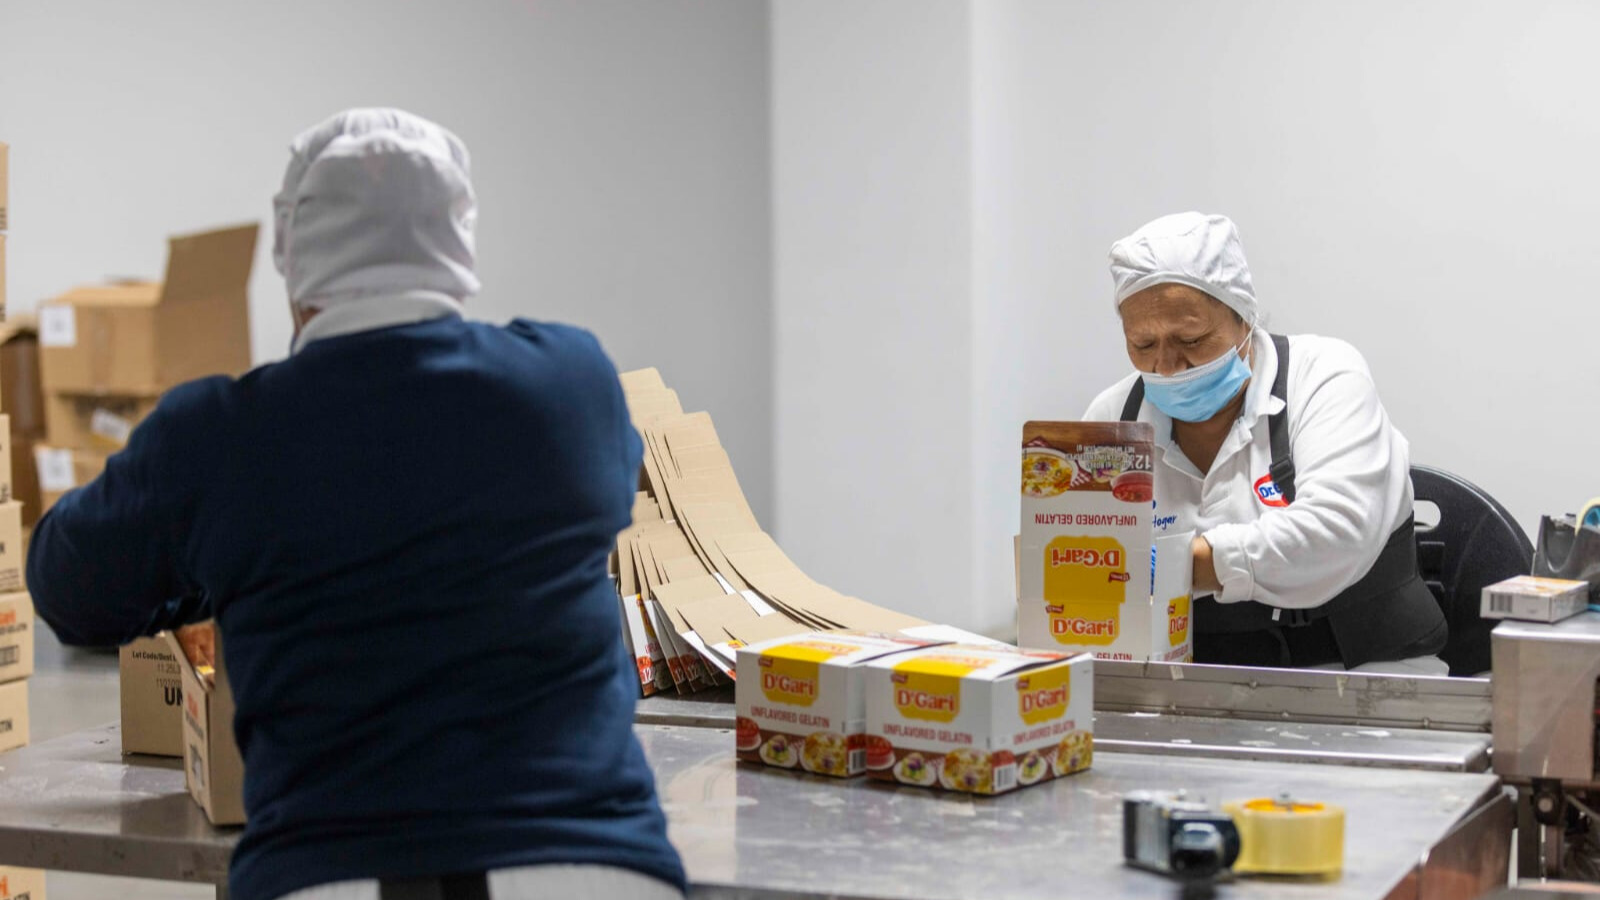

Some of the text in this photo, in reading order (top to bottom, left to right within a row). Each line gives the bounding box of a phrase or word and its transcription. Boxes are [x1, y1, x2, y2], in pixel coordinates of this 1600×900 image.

[1035, 513, 1137, 526] UNFLAVORED GELATIN
[1051, 548, 1120, 567] D'Gari
[1053, 618, 1114, 636] D'Gari
[763, 672, 815, 696] D'Gari
[897, 688, 955, 713] D'Gari
[1022, 683, 1067, 714] D'Gari
[750, 705, 831, 729] UNFLAVORED GELATIN
[882, 722, 974, 746] UNFLAVORED GELATIN
